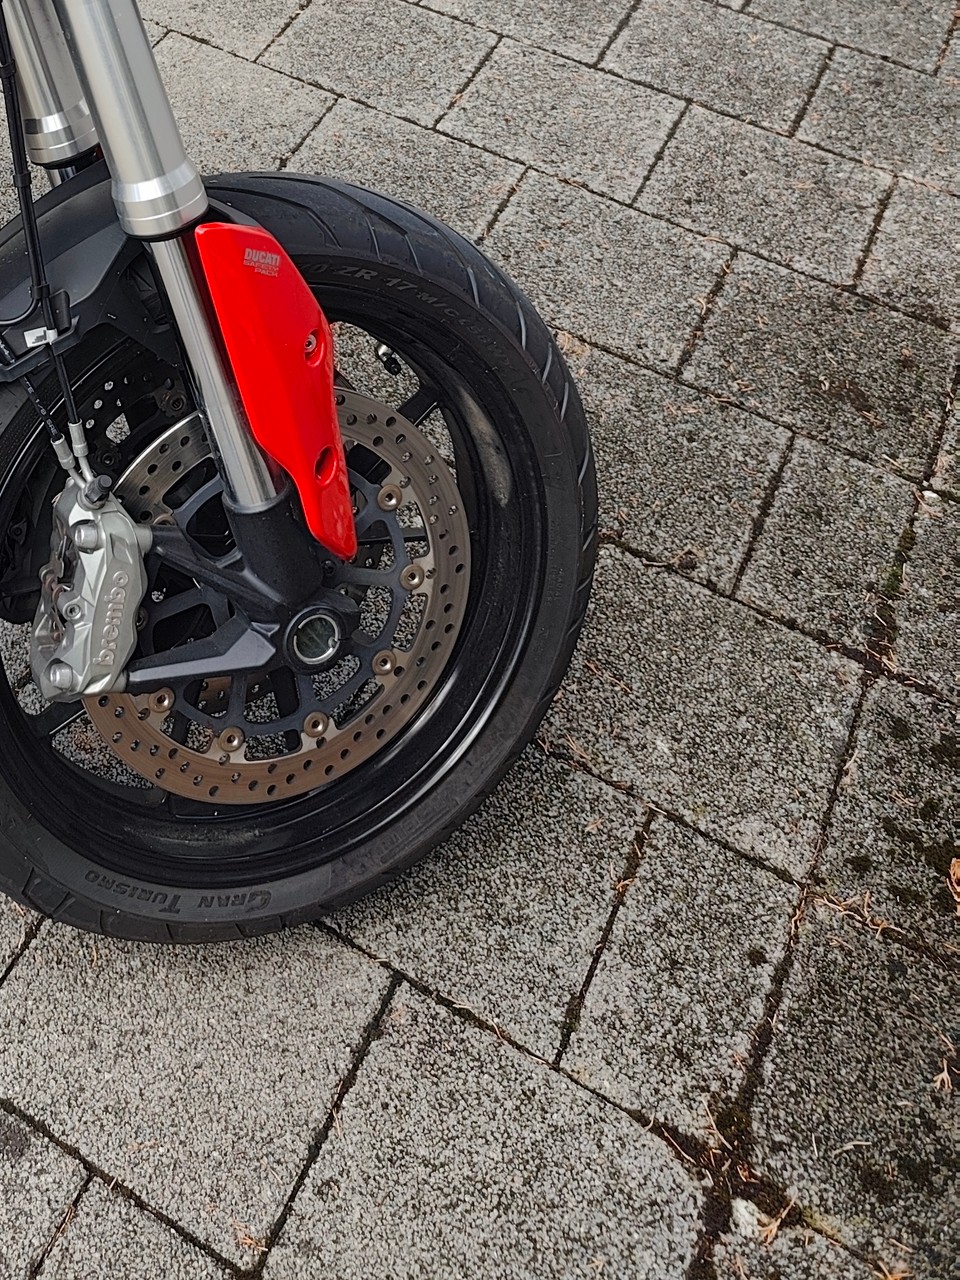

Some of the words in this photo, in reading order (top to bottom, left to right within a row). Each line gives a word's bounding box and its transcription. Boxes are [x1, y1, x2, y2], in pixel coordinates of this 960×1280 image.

[244, 247, 280, 267] DUCATI
[340, 264, 378, 281] ZR
[384, 277, 418, 292] 17
[93, 570, 129, 665] brembo
[84, 870, 182, 915] TURISMO
[197, 889, 272, 913] GRAN
